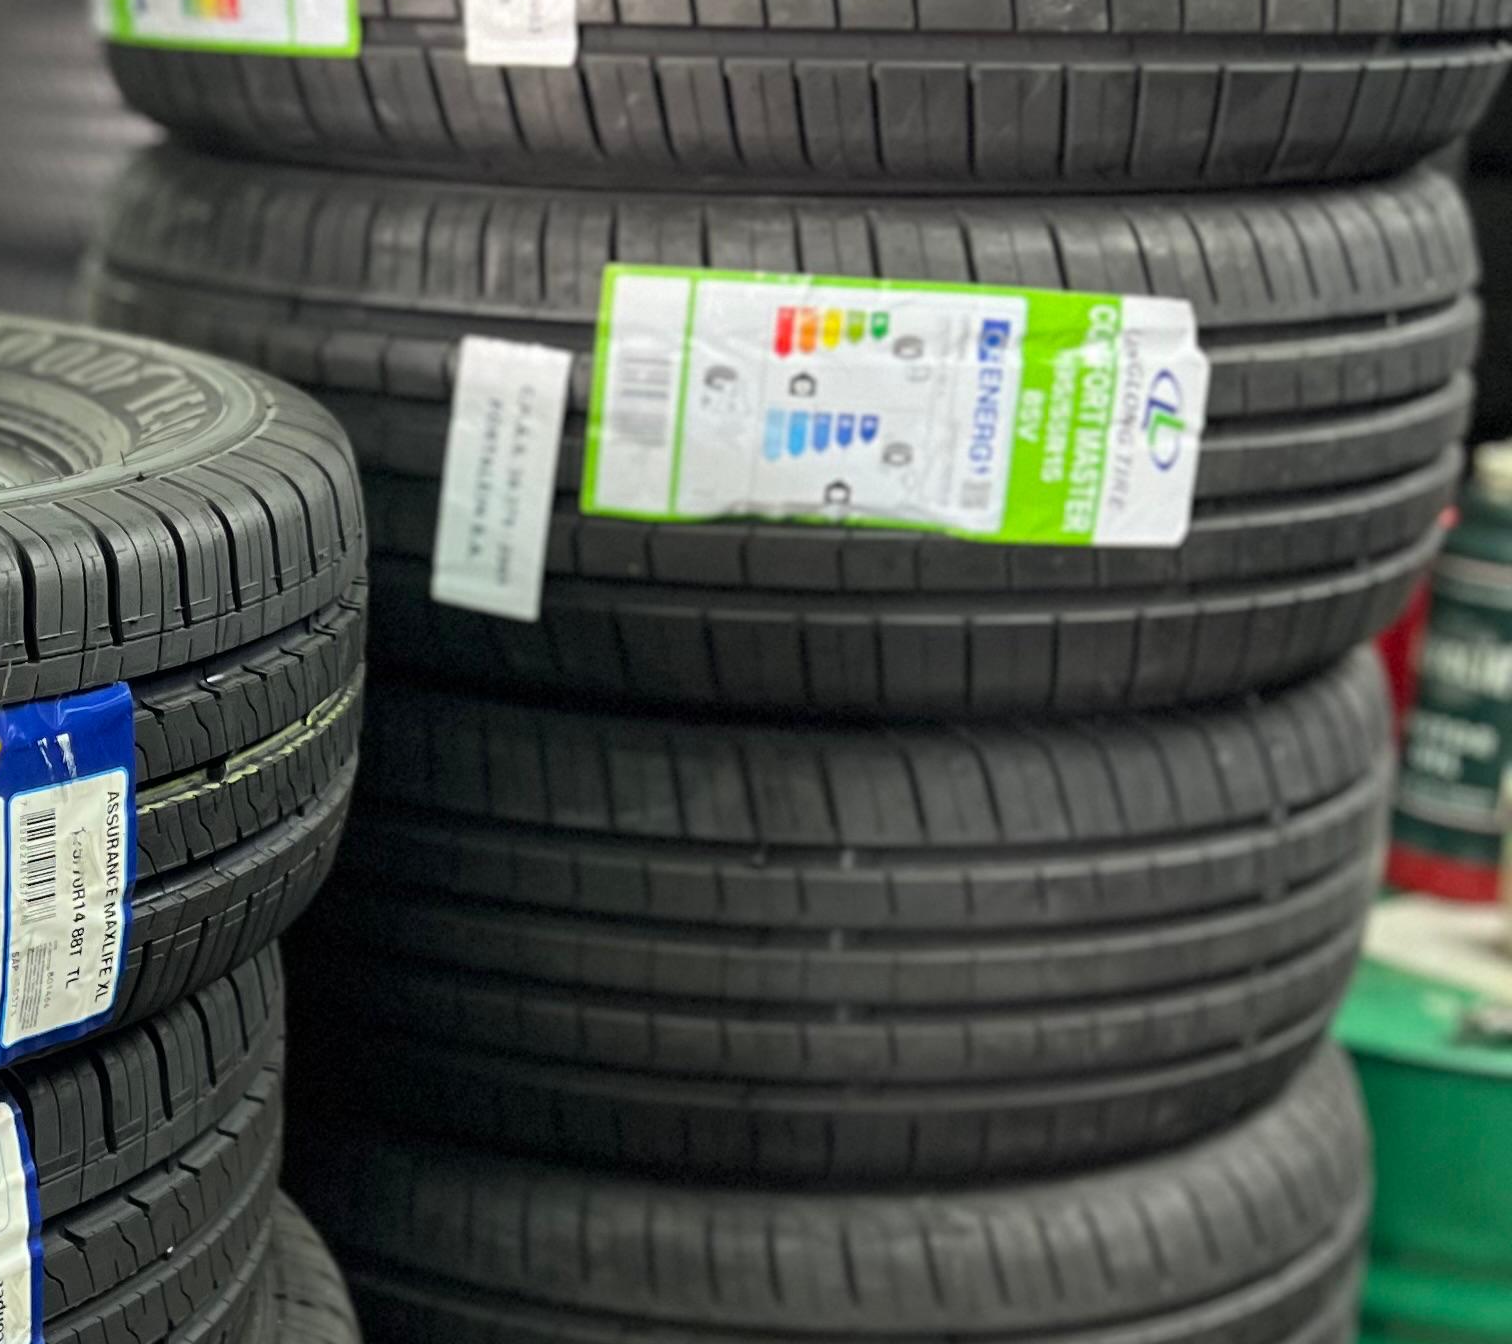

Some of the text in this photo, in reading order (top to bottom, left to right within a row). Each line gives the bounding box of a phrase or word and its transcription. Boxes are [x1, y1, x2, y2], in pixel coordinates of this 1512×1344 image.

[1063, 429, 1107, 533] MASTER
[94, 791, 120, 1003] ASSURANCE MAXLIFE XL
[69, 927, 85, 956] 88T
[10, 951, 21, 972] SAP
[65, 967, 80, 989] TL
